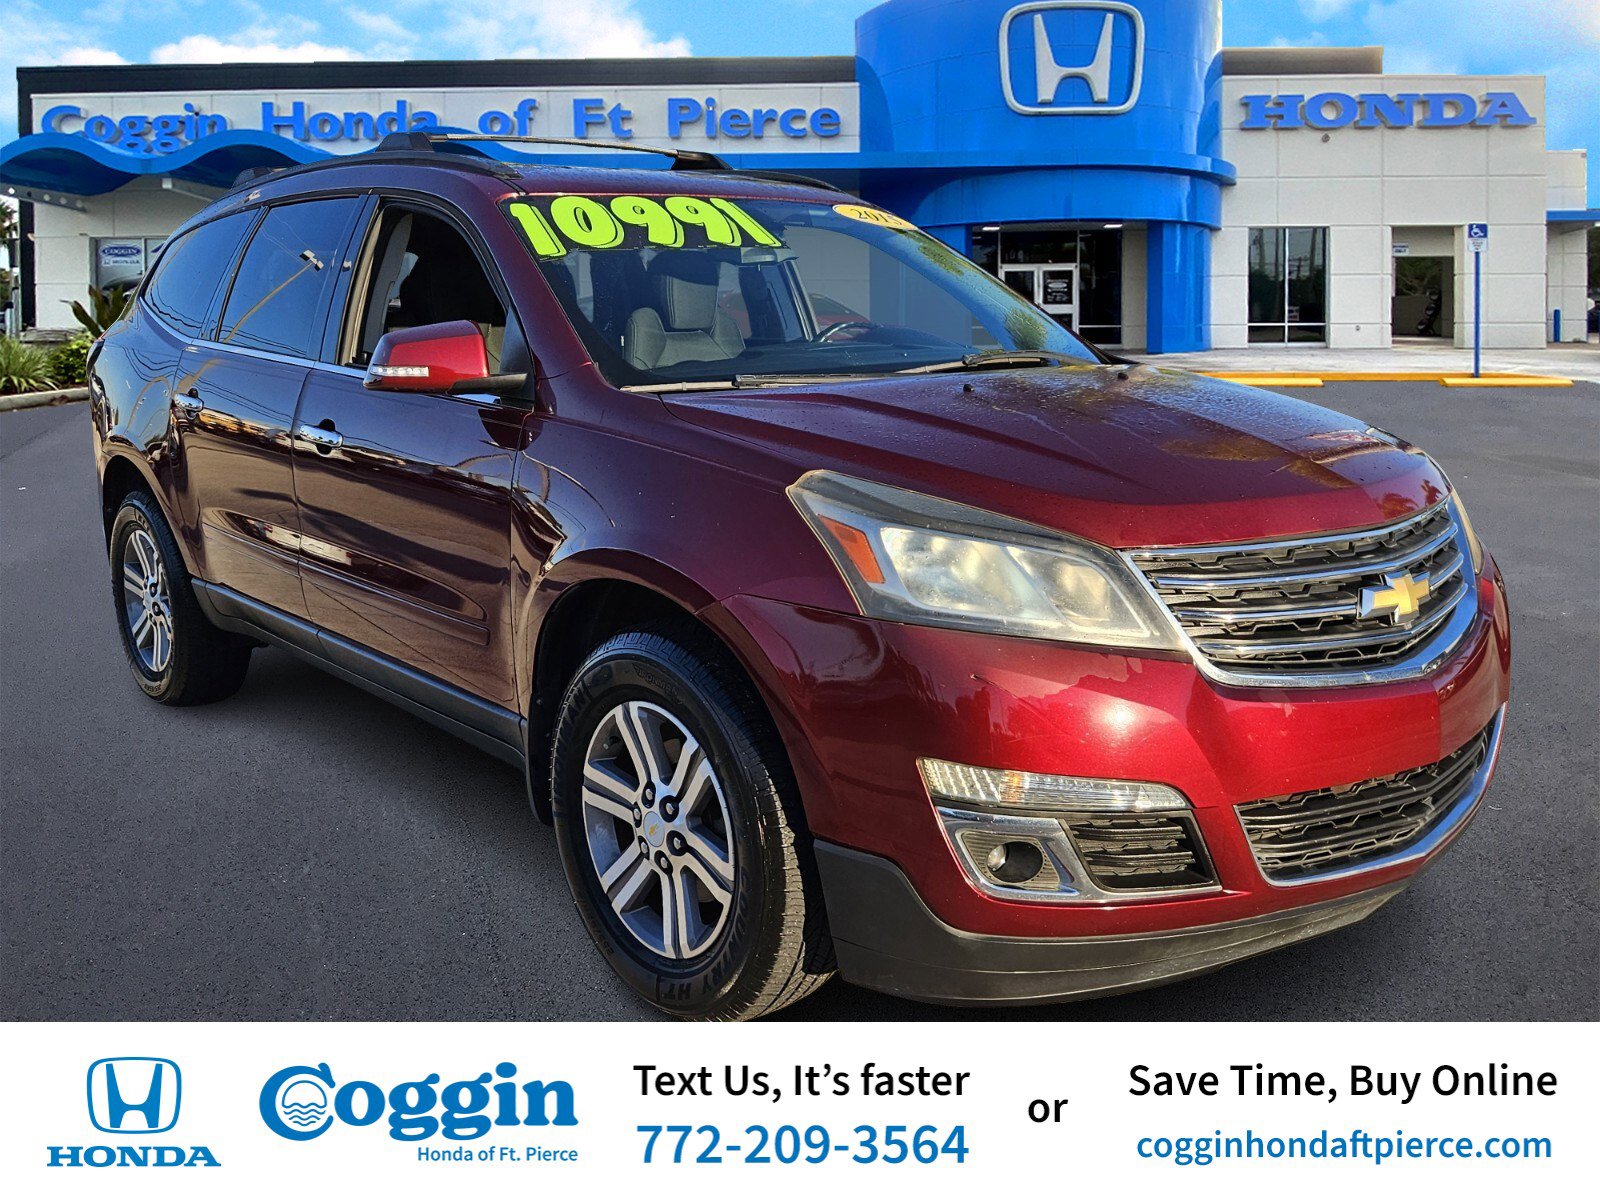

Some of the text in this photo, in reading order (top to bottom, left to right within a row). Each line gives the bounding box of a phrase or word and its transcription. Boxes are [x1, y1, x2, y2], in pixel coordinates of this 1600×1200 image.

[41, 97, 841, 154] Coggin Honda of Ft Pierce
[1240, 92, 1537, 129] HONDA
[509, 195, 782, 257] 10991
